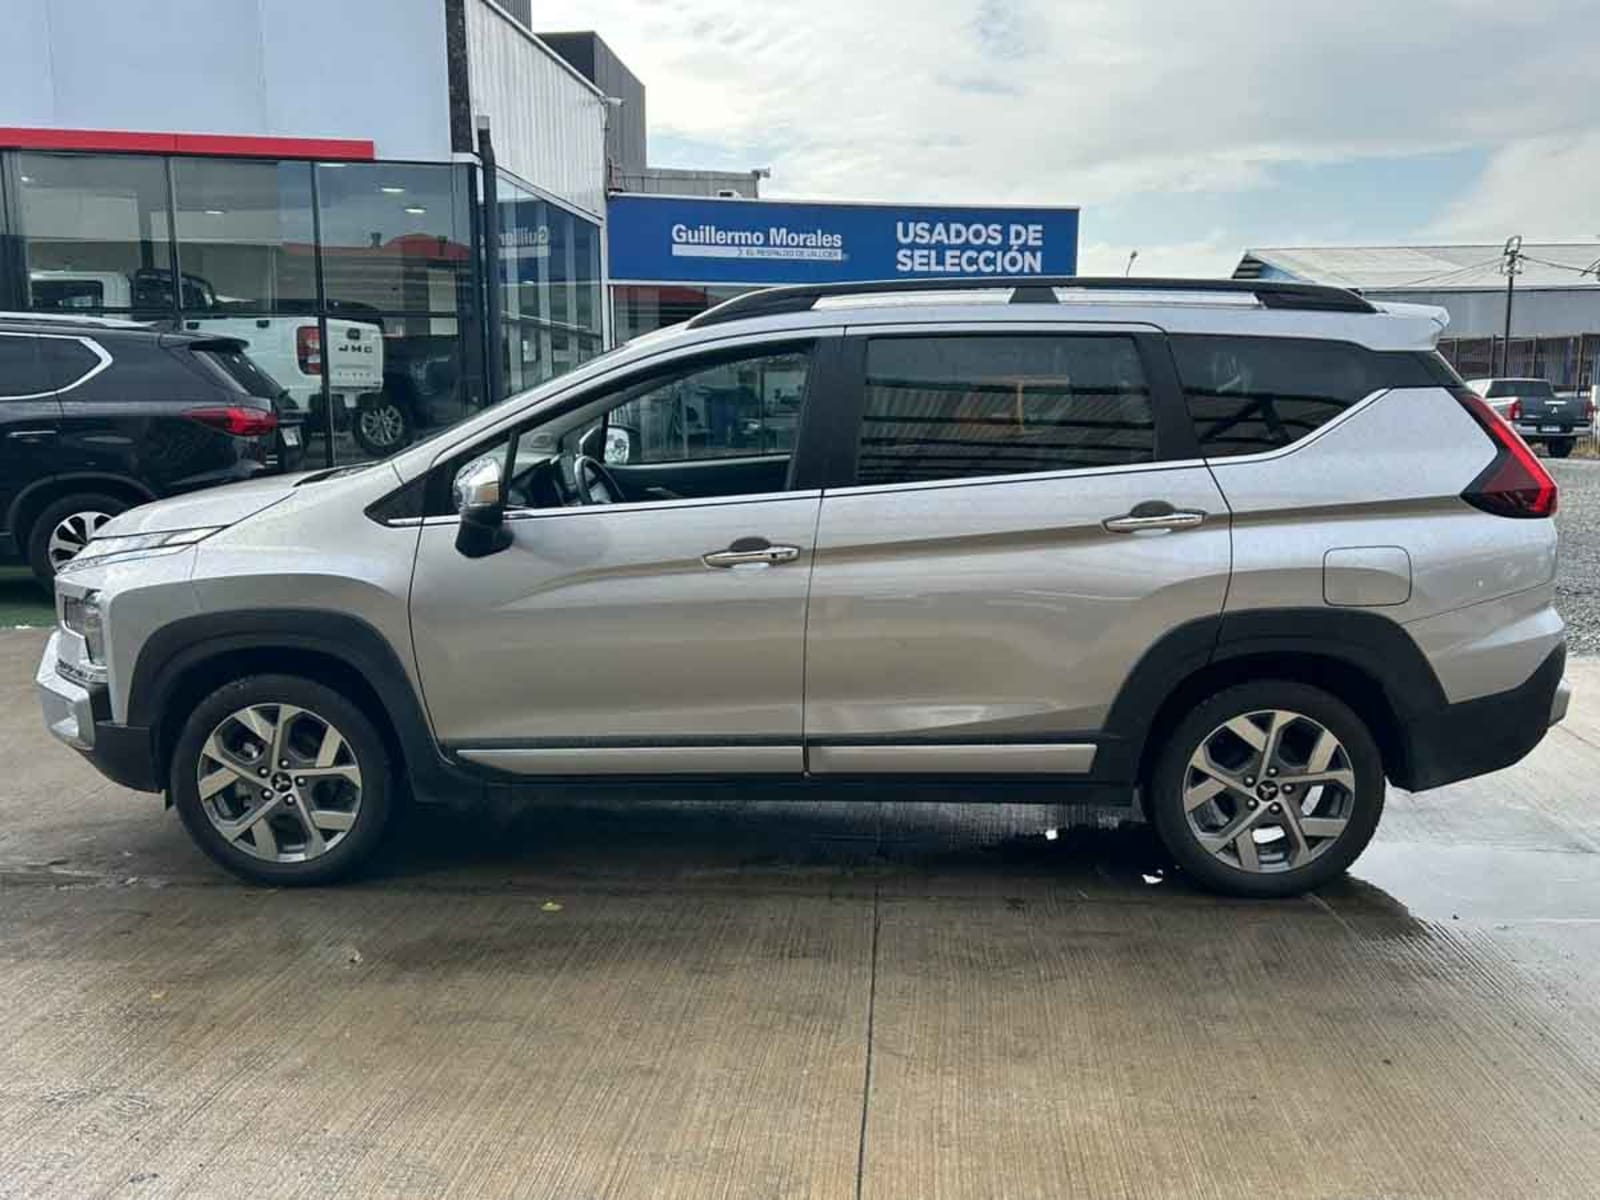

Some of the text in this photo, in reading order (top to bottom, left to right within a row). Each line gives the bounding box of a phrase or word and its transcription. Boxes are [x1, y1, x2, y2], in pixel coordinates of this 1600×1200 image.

[672, 223, 842, 247] Guillermo Morales
[896, 221, 1043, 246] USADOS DE
[896, 246, 1042, 273] SELECCIÓN
